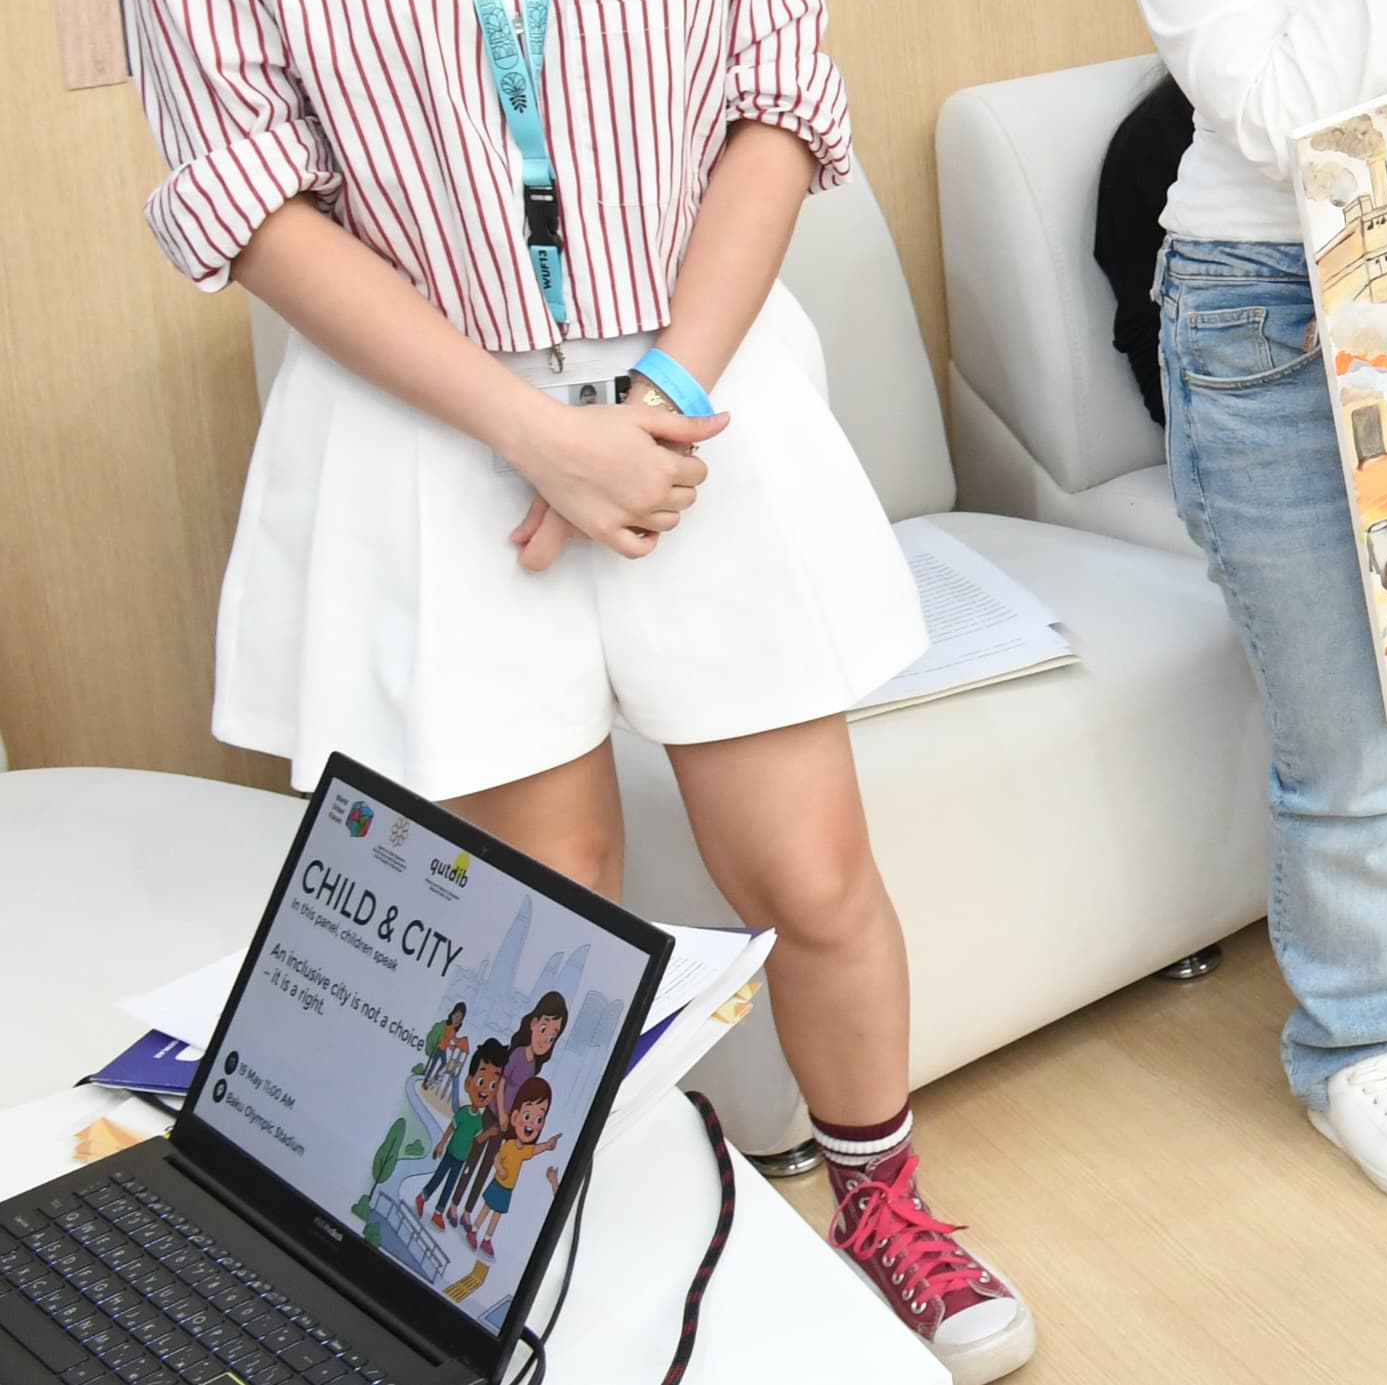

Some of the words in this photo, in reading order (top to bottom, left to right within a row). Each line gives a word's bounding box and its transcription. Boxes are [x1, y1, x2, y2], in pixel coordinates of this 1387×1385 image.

[538, 249, 552, 291] WUF13
[430, 857, 469, 888] qutdib
[291, 898, 302, 911] In
[300, 902, 316, 921] this
[314, 912, 340, 939] panel,
[340, 928, 374, 957] children
[372, 949, 399, 973] speak
[302, 859, 377, 926] CHILD
[377, 905, 399, 943] &
[401, 919, 464, 977] CITY
[270, 942, 288, 963] An
[286, 948, 331, 991] inclusive
[330, 981, 352, 1007] city
[350, 991, 362, 1010] is
[361, 1000, 382, 1024] not
[380, 1014, 389, 1028] a
[388, 1016, 425, 1052] choice
[271, 969, 284, 987] it
[281, 975, 293, 994] is
[289, 983, 299, 998] a
[298, 987, 325, 1017] right.
[246, 1067, 263, 1090] May
[226, 1091, 245, 1113] Baku
[244, 1105, 273, 1135] Olympic
[273, 1126, 305, 1158] Stadium
